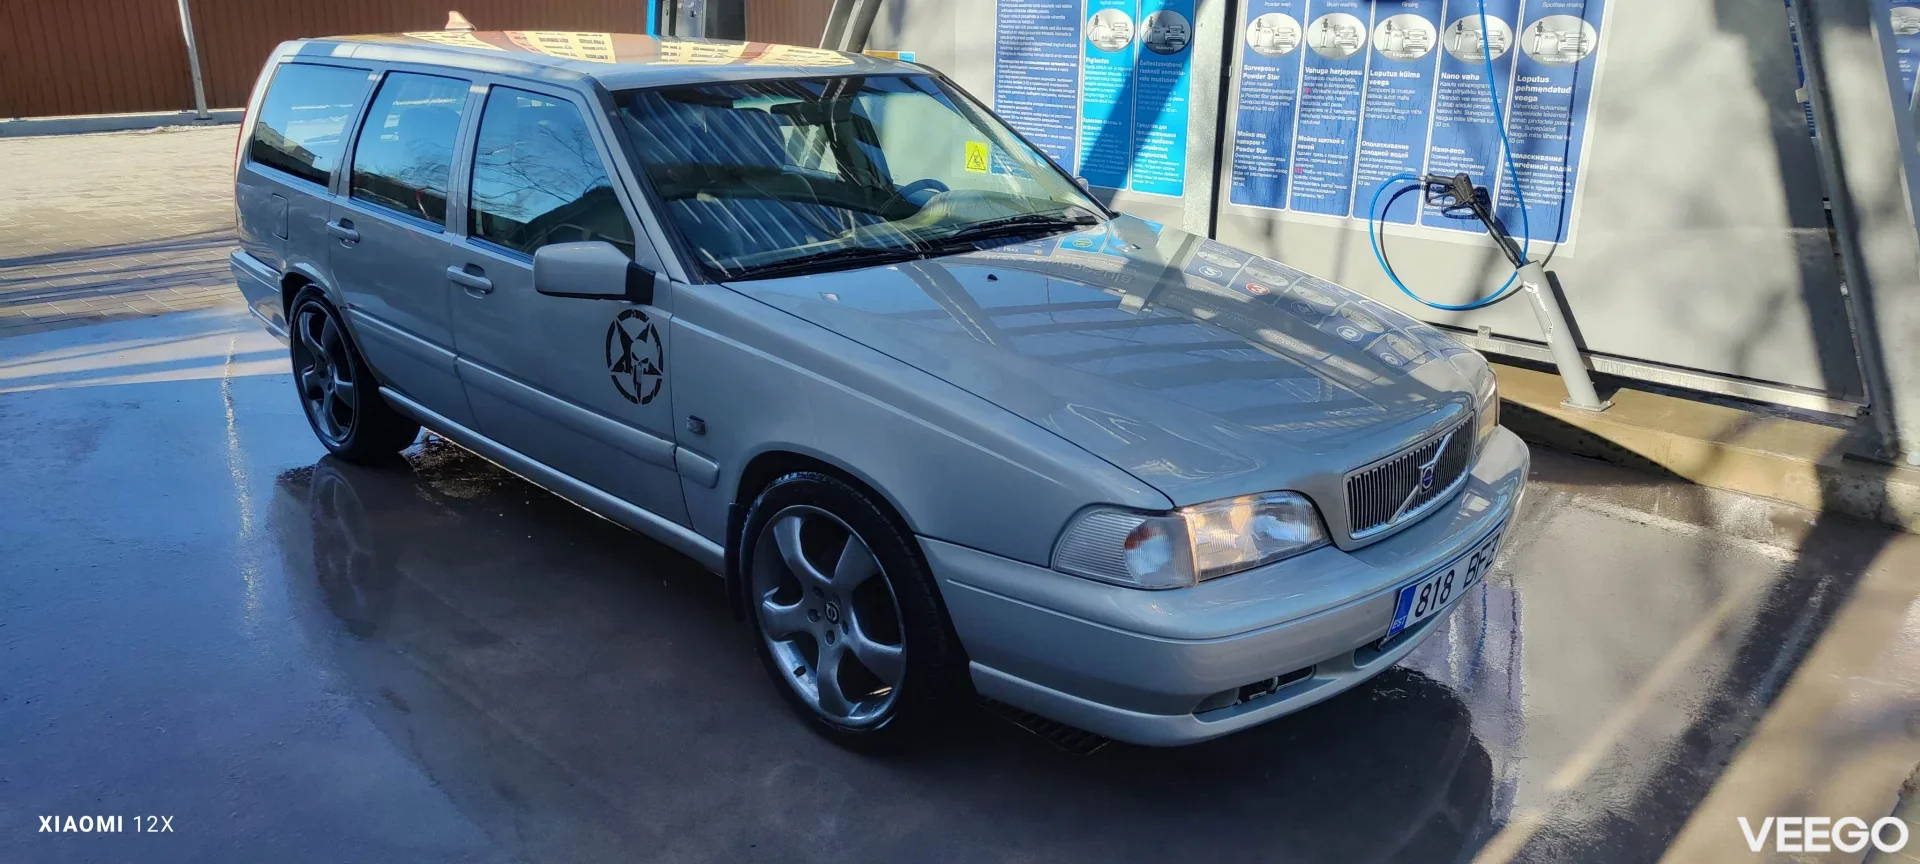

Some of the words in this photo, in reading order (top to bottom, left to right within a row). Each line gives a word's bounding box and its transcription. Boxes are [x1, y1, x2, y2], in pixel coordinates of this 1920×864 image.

[1305, 66, 1328, 74] Vahuga
[1370, 70, 1398, 78] Loputus
[1399, 70, 1420, 78] külma
[1516, 74, 1550, 84] Loputus
[1516, 84, 1572, 94] pehmendatud
[1414, 569, 1455, 618] 818
[1463, 532, 1501, 590] BFZ
[1392, 616, 1407, 630] EST
